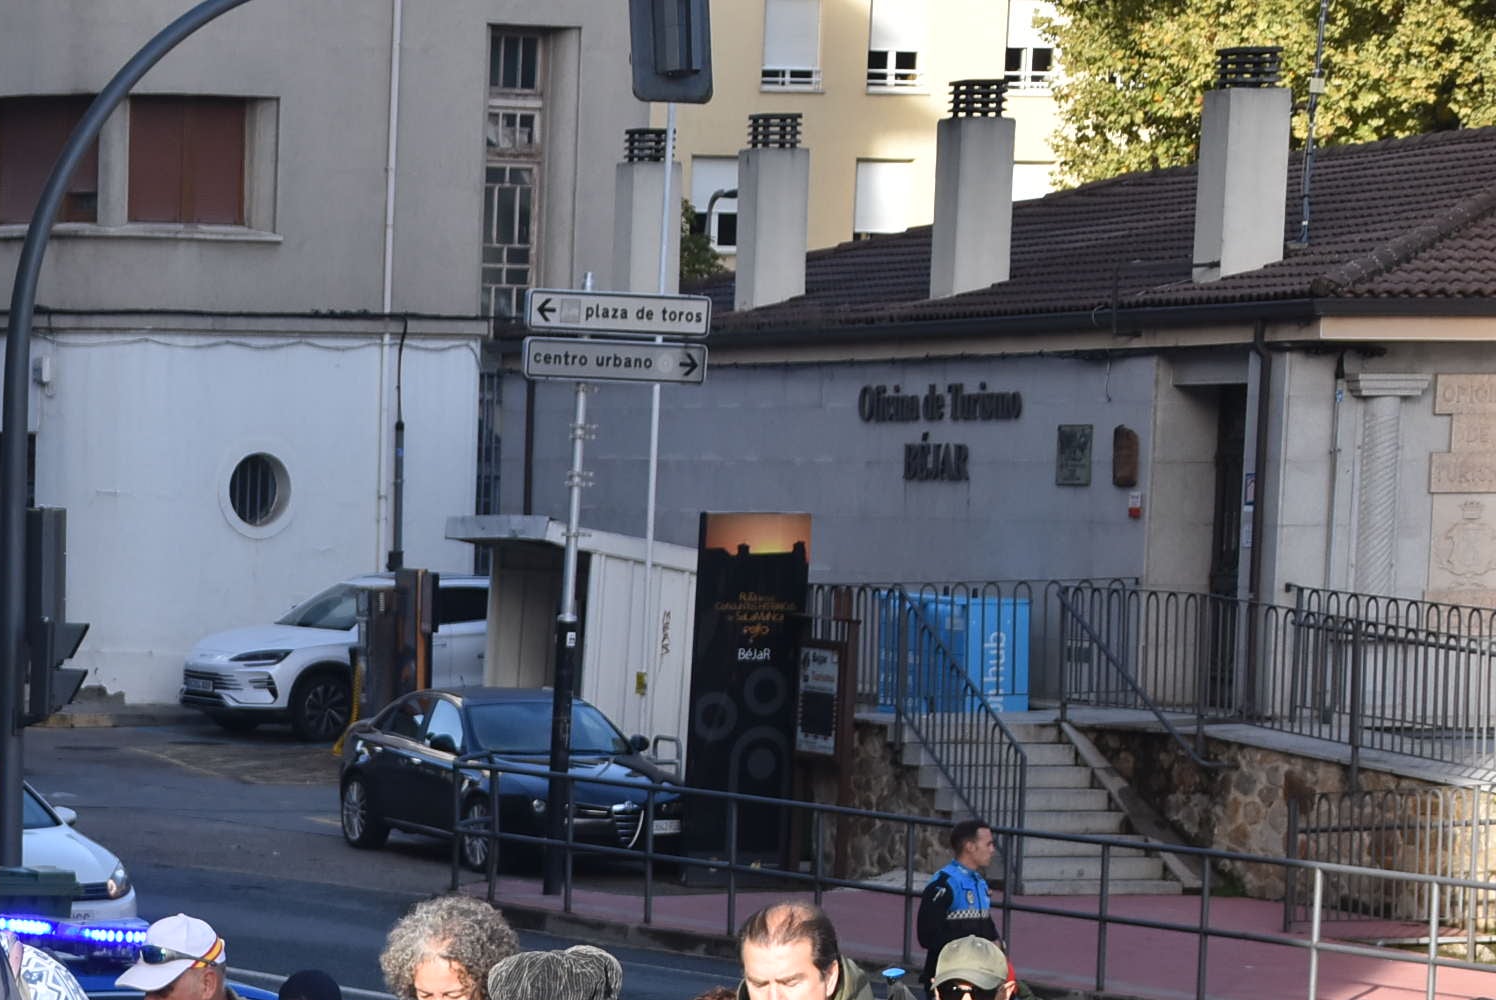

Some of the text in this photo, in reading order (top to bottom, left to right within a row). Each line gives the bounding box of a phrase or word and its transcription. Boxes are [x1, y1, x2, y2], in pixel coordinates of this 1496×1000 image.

[585, 303, 703, 323] plaza de toros
[533, 350, 653, 369] centro urbano
[858, 381, 1023, 422] Oficina de Turismo
[903, 431, 969, 481] BÉJAR
[983, 631, 1006, 682] hub
